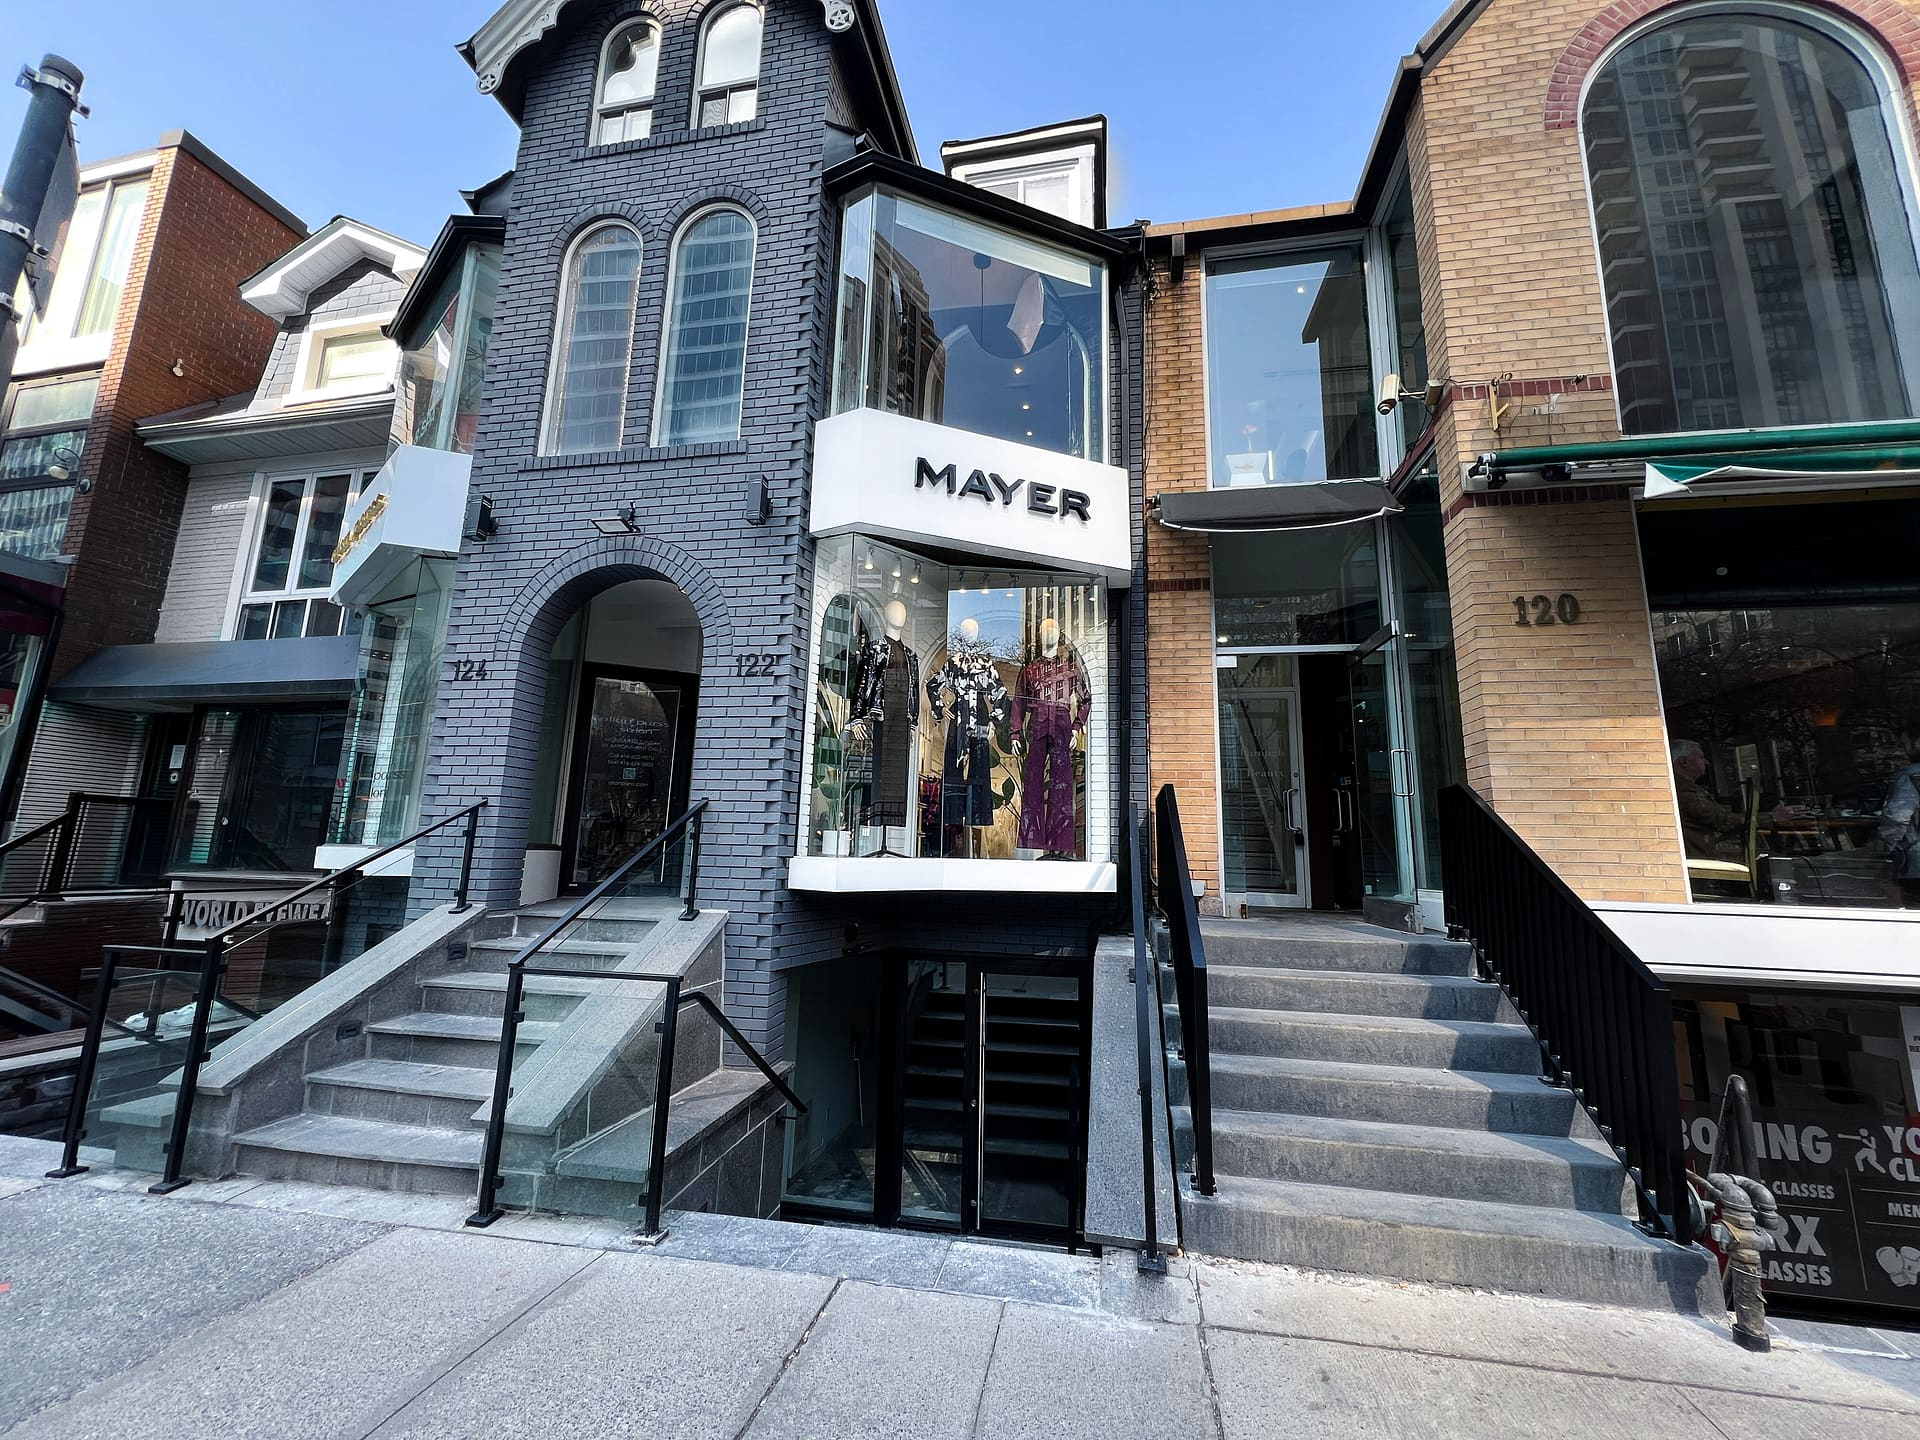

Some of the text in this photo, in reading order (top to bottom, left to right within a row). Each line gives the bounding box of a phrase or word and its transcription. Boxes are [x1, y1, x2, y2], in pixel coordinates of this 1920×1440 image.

[914, 456, 1092, 521] MAYER
[1512, 594, 1579, 625] 120
[453, 659, 487, 681] 124
[735, 653, 778, 677] 122
[182, 900, 248, 928] WORLD
[1772, 1180, 1836, 1200] CLASSES
